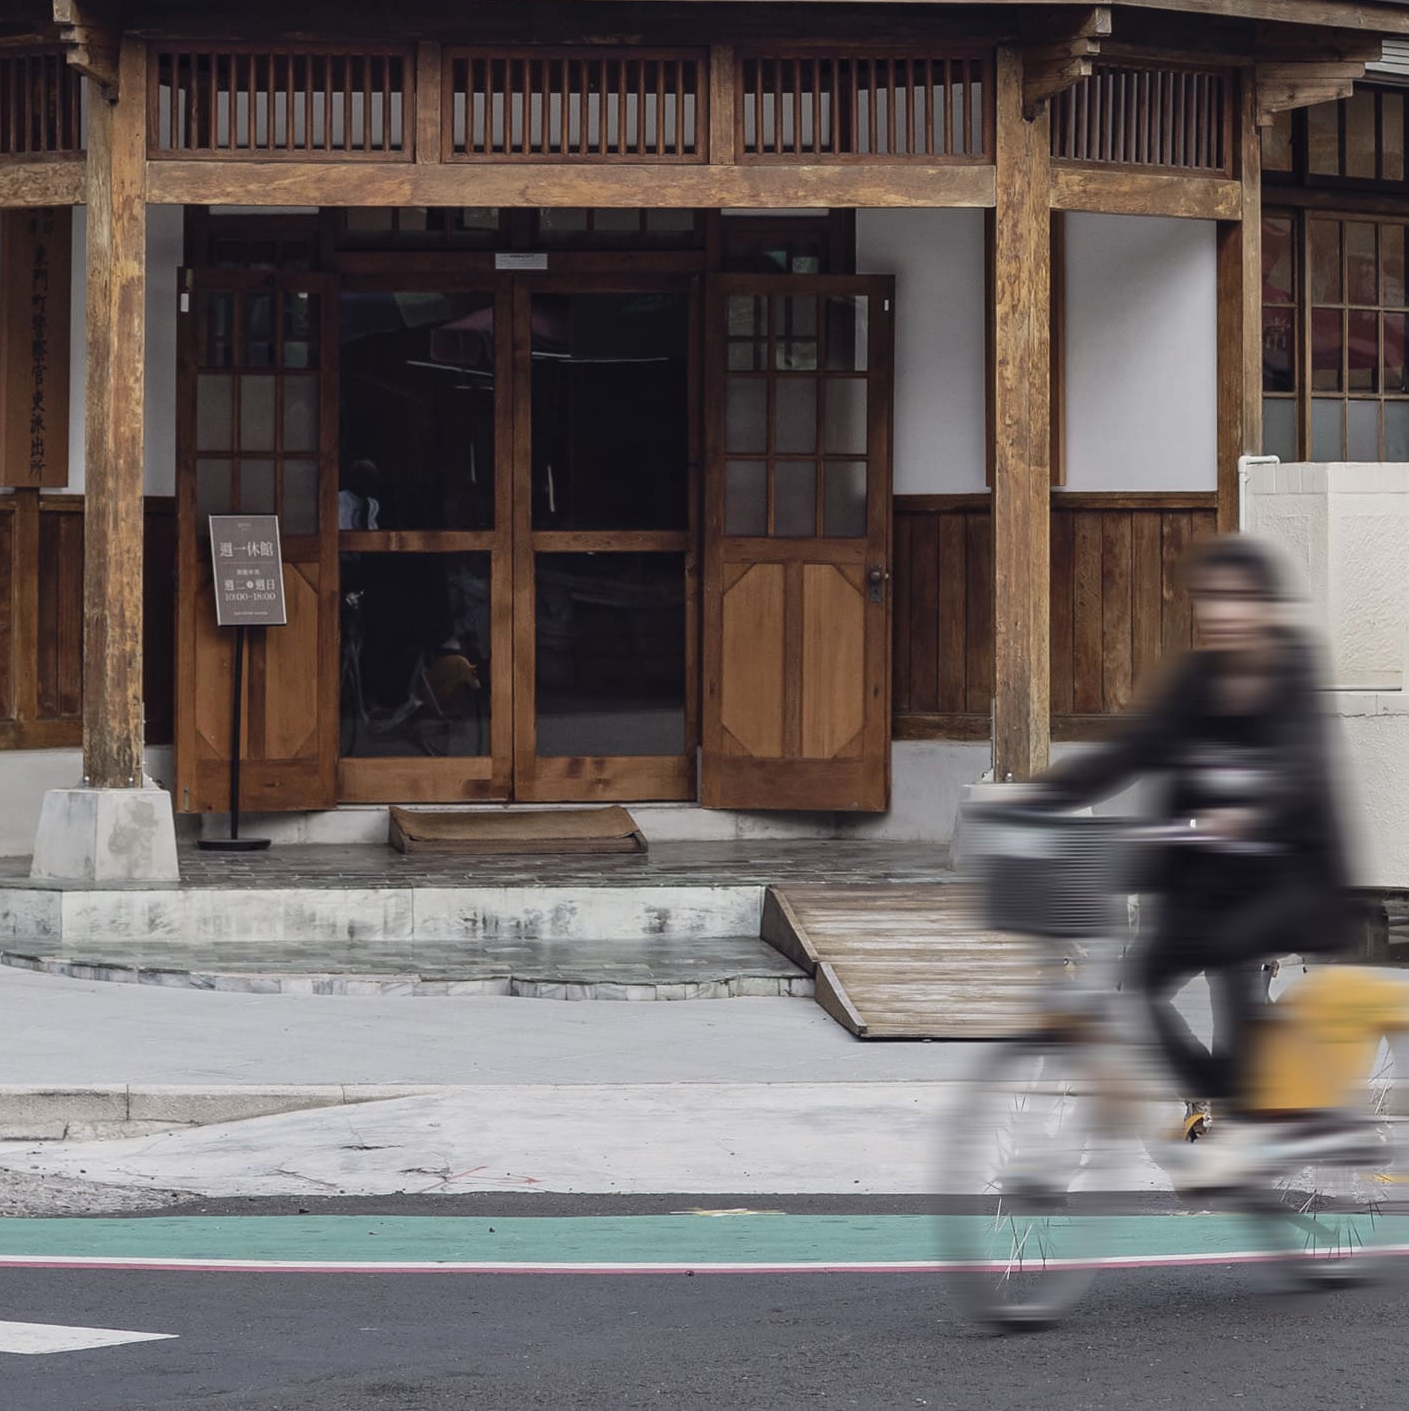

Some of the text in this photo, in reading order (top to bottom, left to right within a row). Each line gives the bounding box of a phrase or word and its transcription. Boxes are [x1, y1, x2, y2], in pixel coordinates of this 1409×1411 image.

[220, 542, 273, 557] 週一休館
[225, 592, 276, 602] 10:00-18:00
